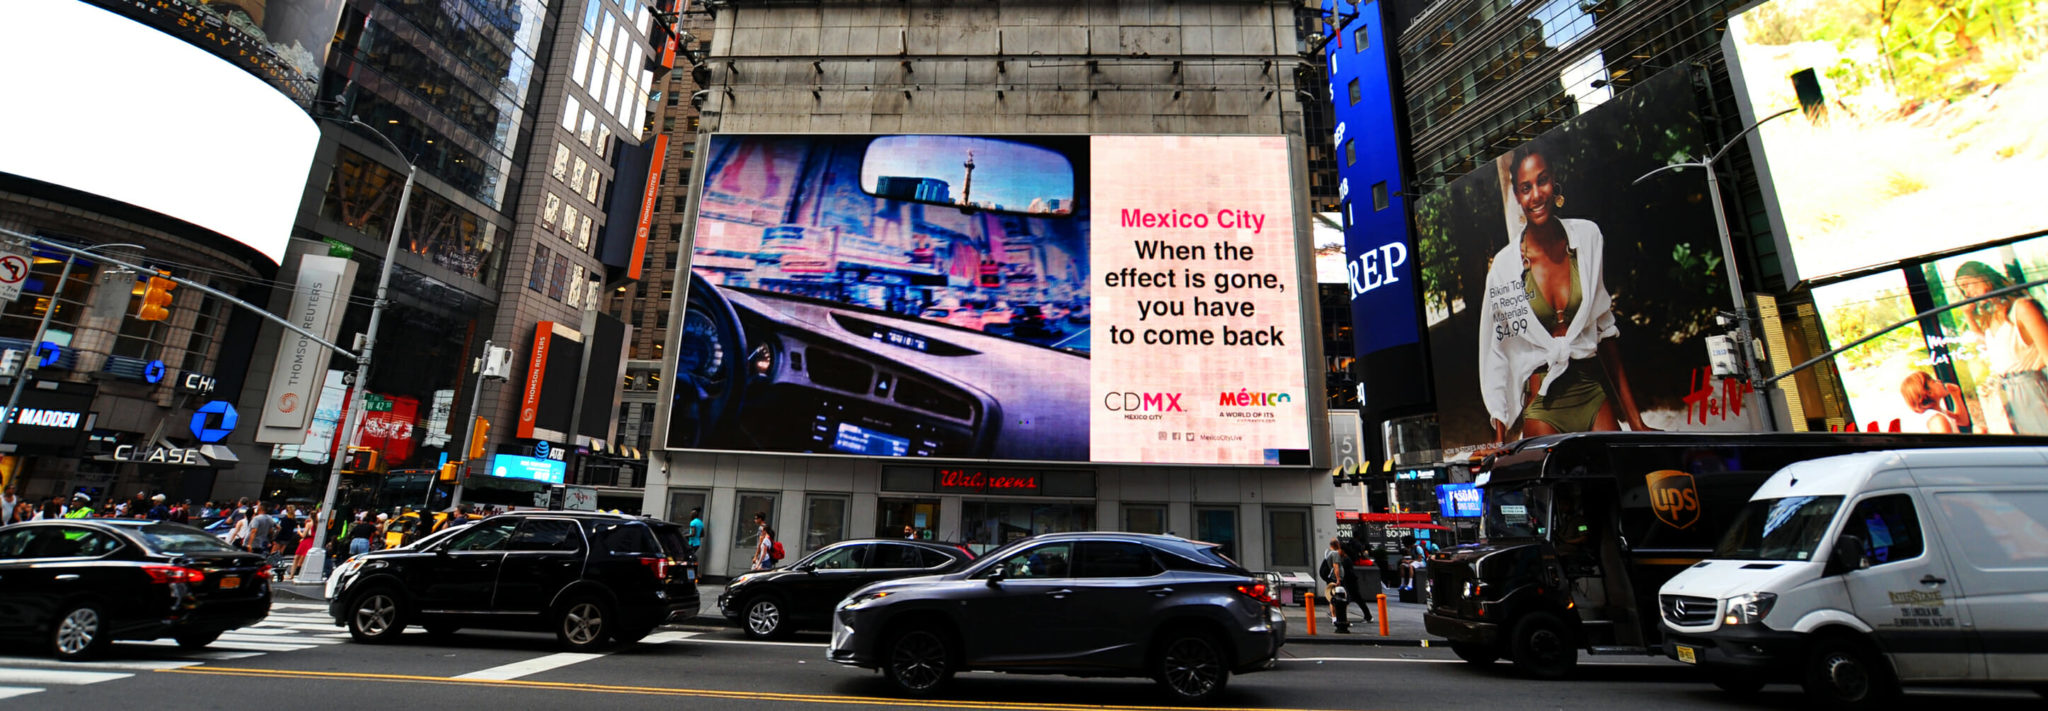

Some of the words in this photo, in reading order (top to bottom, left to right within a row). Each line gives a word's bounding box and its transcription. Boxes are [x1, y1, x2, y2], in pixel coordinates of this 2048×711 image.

[1121, 208, 1209, 229] Mexico
[1217, 208, 1265, 234] City
[1134, 240, 1206, 260] When
[1213, 240, 1255, 261] the
[1105, 267, 1177, 288] effect
[1184, 268, 1206, 288] is
[1214, 271, 1285, 294] gone,
[1489, 283, 1510, 299] Bikini
[302, 281, 323, 330] REUTERS
[1138, 300, 1184, 321] you
[1194, 296, 1255, 317] have
[1500, 289, 1536, 308] Recycled
[1493, 305, 1529, 323] Materials
[1110, 325, 1135, 345] to
[1143, 327, 1215, 346] come
[1223, 325, 1286, 346] back
[1495, 318, 1528, 342] $4.99
[528, 368, 540, 404] THOMSON
[534, 336, 546, 369] REUTERS
[1104, 391, 1182, 412] CDMX
[18, 408, 80, 429] MADDEN
[114, 444, 199, 464] CHASE
[940, 469, 1037, 493] Walgreens
[1651, 487, 1697, 521] ups
